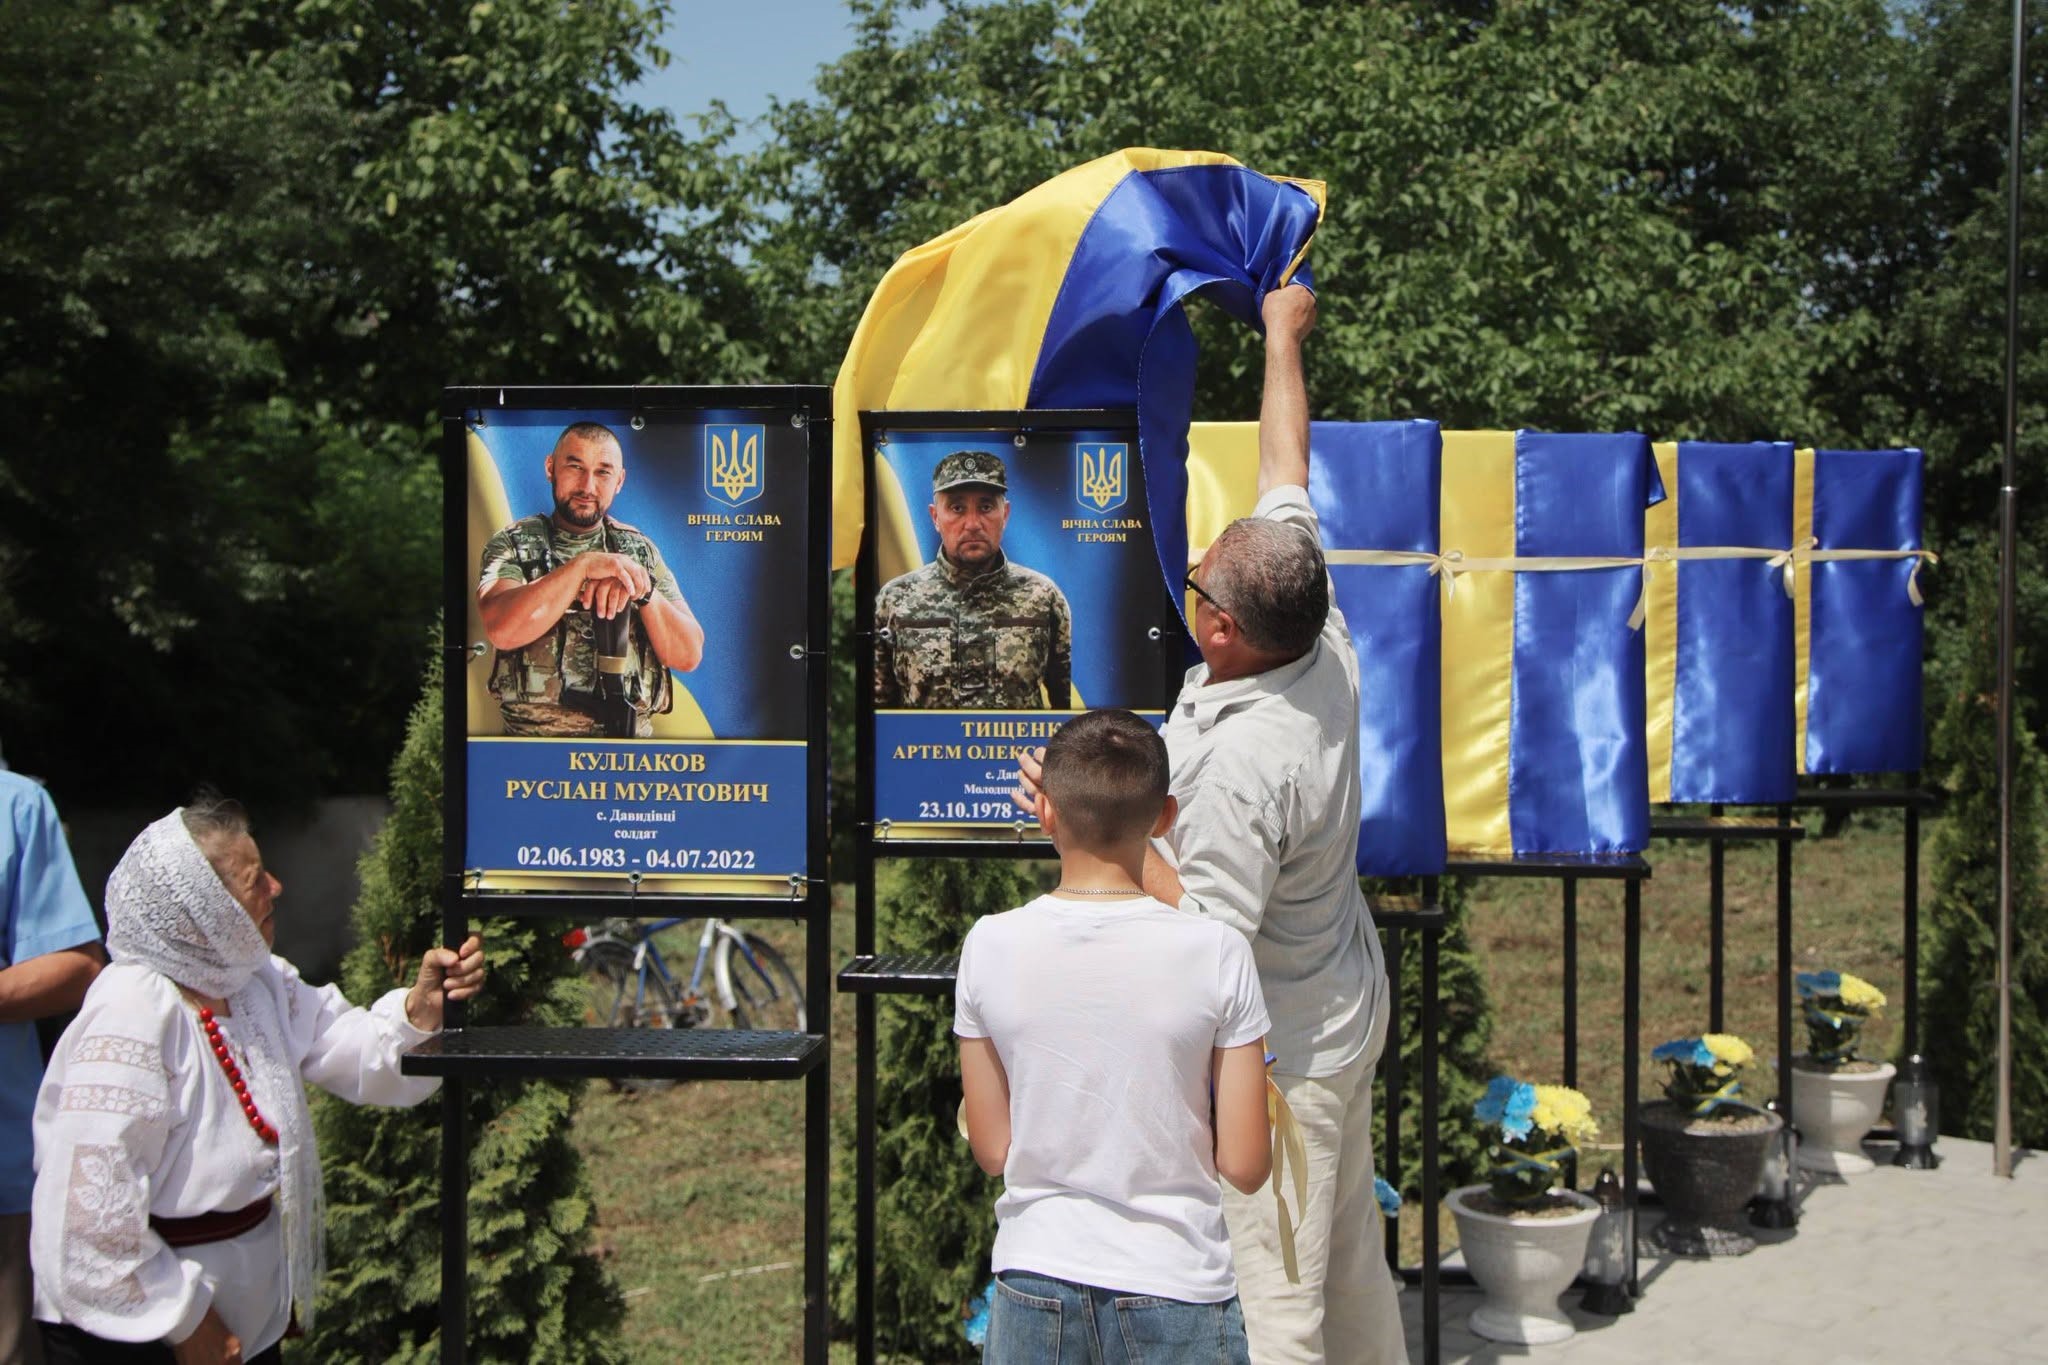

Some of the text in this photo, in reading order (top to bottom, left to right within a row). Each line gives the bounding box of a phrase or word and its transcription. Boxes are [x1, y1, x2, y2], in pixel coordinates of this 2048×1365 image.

[687, 514, 782, 526] ВІЧНА СЛАВА
[1062, 519, 1143, 529] ВІЧНА СЛАВА
[705, 530, 764, 542] ГЕРОЯМ
[1077, 533, 1127, 543] ГЕРОЯМ
[961, 721, 1062, 741] ТИЩЕНК
[893, 745, 962, 760] АРТЕМ
[568, 752, 706, 772] КУЛЛАКОВ
[985, 770, 995, 780] с.
[505, 780, 769, 803] РУСЛАН МУРАТОВИЧ
[596, 808, 676, 823] с. Давидівці
[919, 802, 1013, 819] 23.10.1978
[614, 829, 658, 840] солдат
[517, 846, 627, 866] 02.06.1983
[645, 849, 756, 869] 04.07.2022
